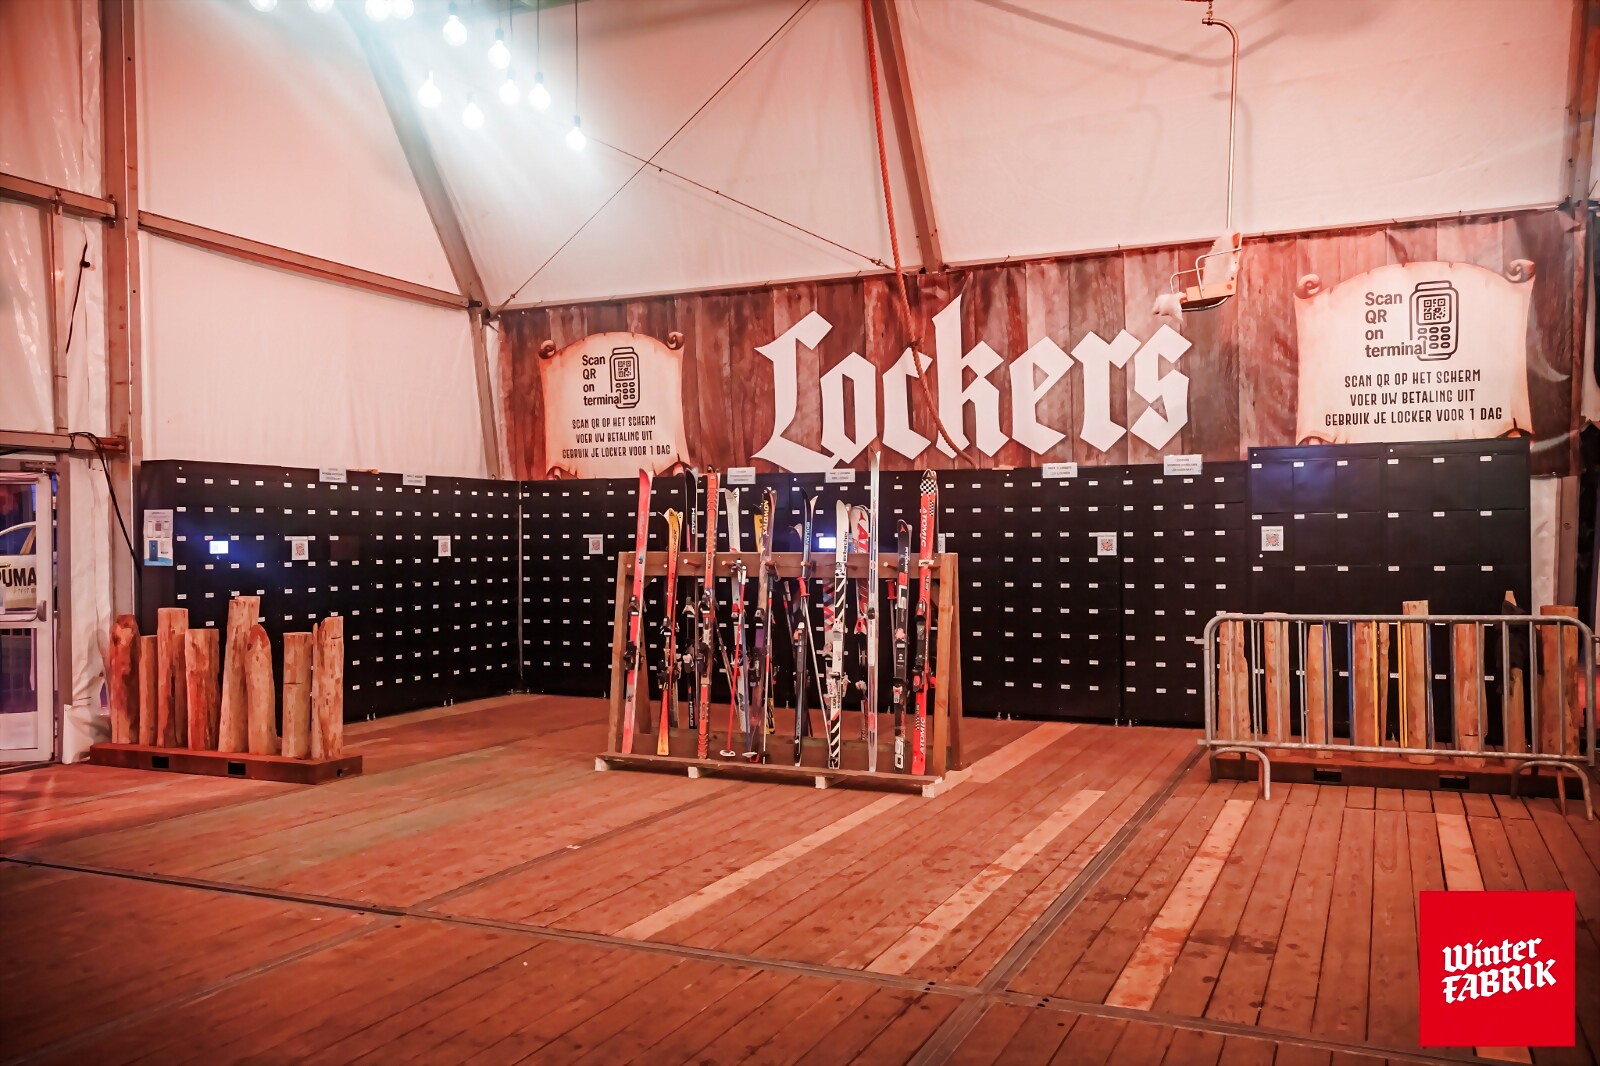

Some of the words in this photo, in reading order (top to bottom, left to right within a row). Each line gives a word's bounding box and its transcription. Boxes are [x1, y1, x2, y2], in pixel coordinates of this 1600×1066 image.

[1364, 291, 1402, 306] Scan
[1365, 309, 1387, 324] QR
[1365, 328, 1383, 340] on
[1365, 340, 1426, 358] terminal
[582, 355, 606, 365] Scan
[583, 368, 596, 380] QR
[1345, 374, 1372, 388] SCAN
[1377, 373, 1390, 387] QR
[1394, 373, 1408, 385] OP
[1412, 371, 1431, 384] HET
[1436, 369, 1481, 383] SCHERM
[583, 383, 594, 392] on
[750, 294, 1193, 473] Lockers
[584, 393, 622, 406] terminal
[1350, 393, 1377, 406] VOER
[1381, 392, 1397, 405] UW
[1402, 389, 1452, 404] BETALING
[1457, 389, 1475, 402] UIT
[572, 419, 589, 429] SCAN
[591, 418, 600, 428] QR
[602, 418, 610, 427] OP
[613, 417, 626, 427] HET
[629, 416, 656, 426] SCHERM
[1325, 412, 1369, 426] GEBRUIK
[1374, 412, 1387, 424] JE
[1391, 410, 1432, 423] LOCKER
[1436, 409, 1464, 422] VOOR
[1470, 408, 1475, 420] 1
[1480, 407, 1502, 420] DAG
[576, 433, 592, 443] VOER
[595, 432, 605, 442] UW
[608, 431, 640, 442] BETALING
[641, 431, 652, 441] UIT
[562, 448, 589, 459] GEBRUIK
[591, 448, 600, 458] JE
[602, 446, 626, 457] LOCKER
[629, 446, 647, 456] VOOR
[650, 446, 653, 455] 1
[657, 445, 670, 455] DAG
[920, 506, 928, 548] ATOMIC
[0, 567, 36, 587] UMA
